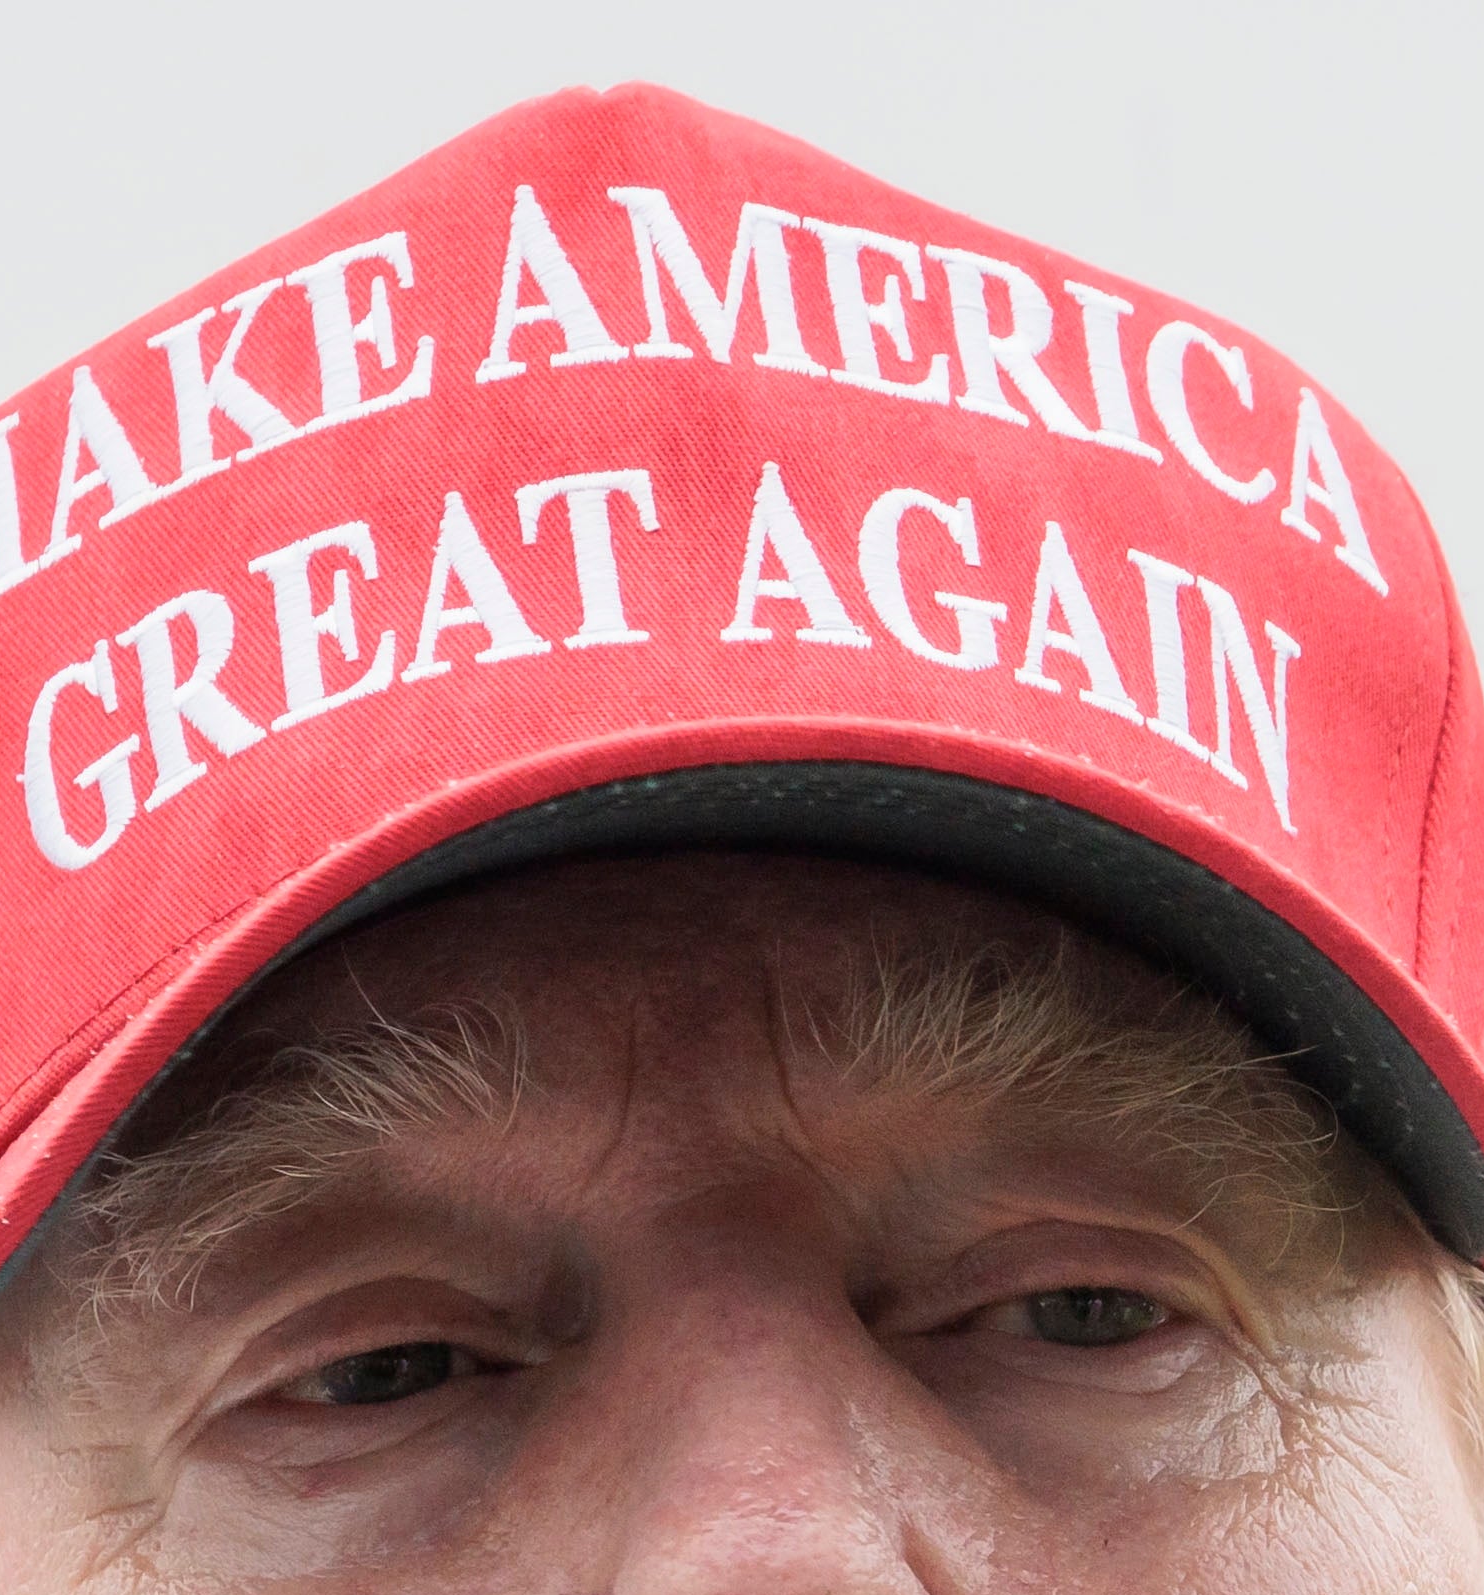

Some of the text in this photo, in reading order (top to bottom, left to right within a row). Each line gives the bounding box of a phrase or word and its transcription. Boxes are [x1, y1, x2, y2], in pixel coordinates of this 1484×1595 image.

[474, 184, 1389, 597] AMERICA
[16, 461, 1301, 870] GREAT AGAIN
